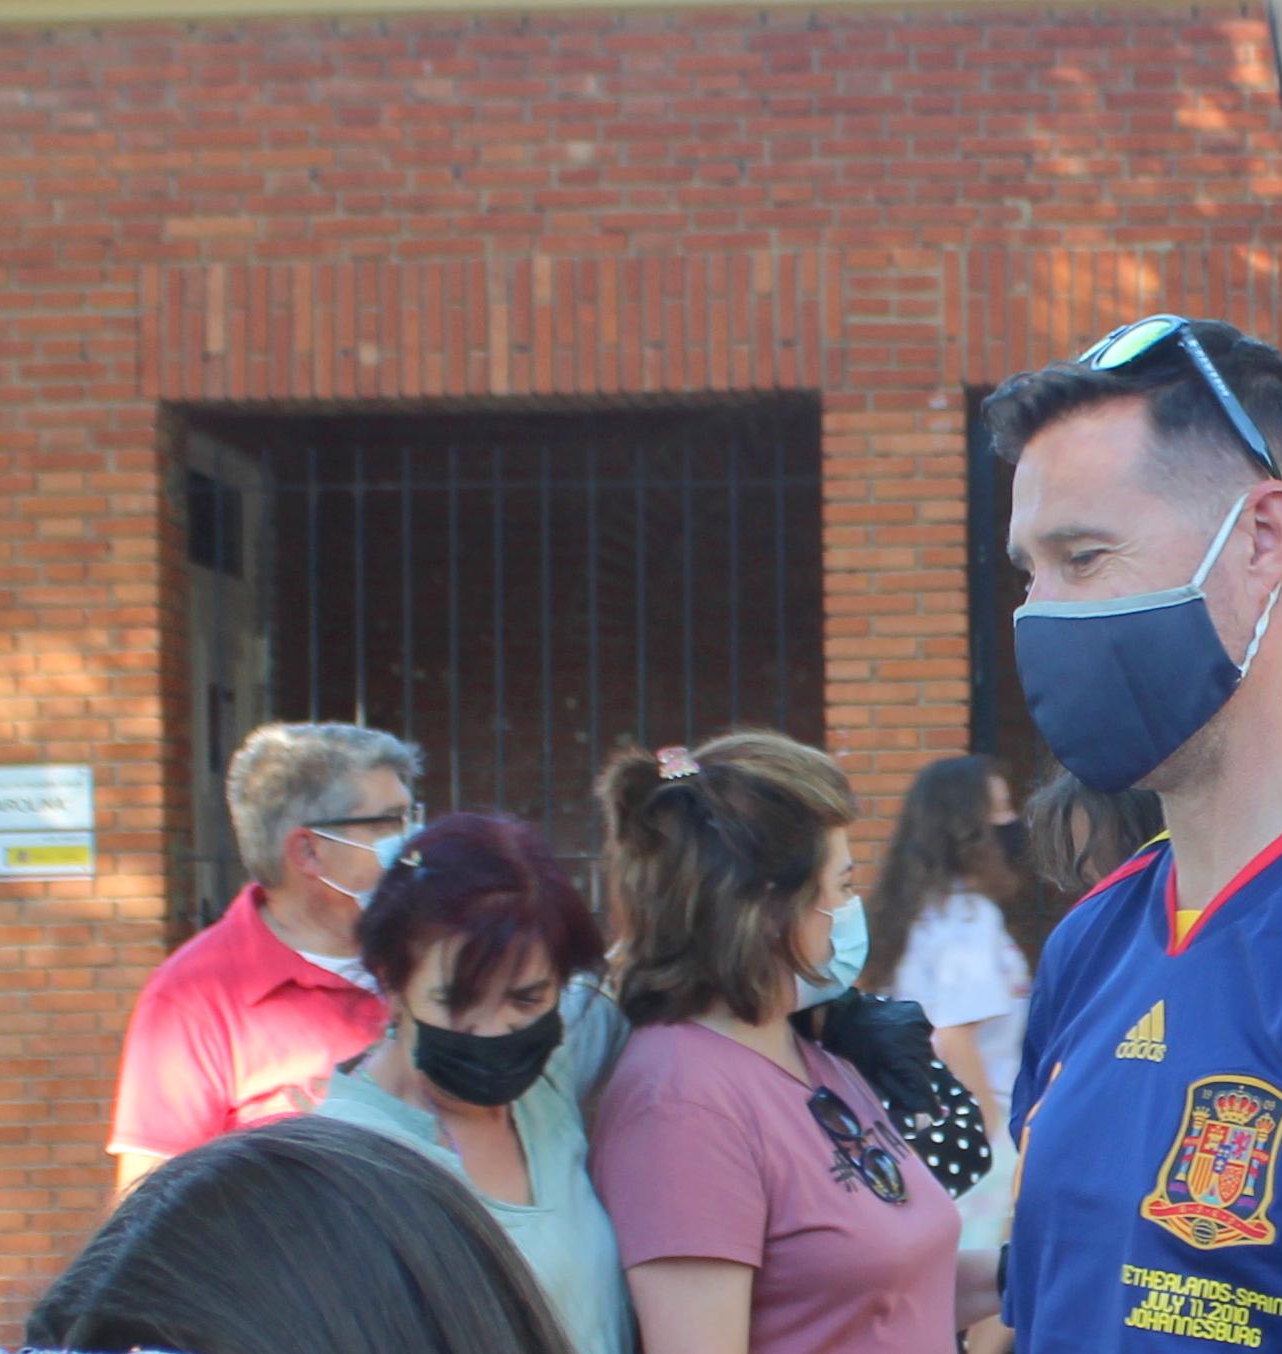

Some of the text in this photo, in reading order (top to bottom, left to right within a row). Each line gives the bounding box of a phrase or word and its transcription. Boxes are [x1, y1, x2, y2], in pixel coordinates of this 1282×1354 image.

[1116, 1041, 1167, 1063] adidas
[1140, 1290, 1250, 1326] JULY 11.2010
[1123, 1306, 1263, 1348] JOHANNESBURG
